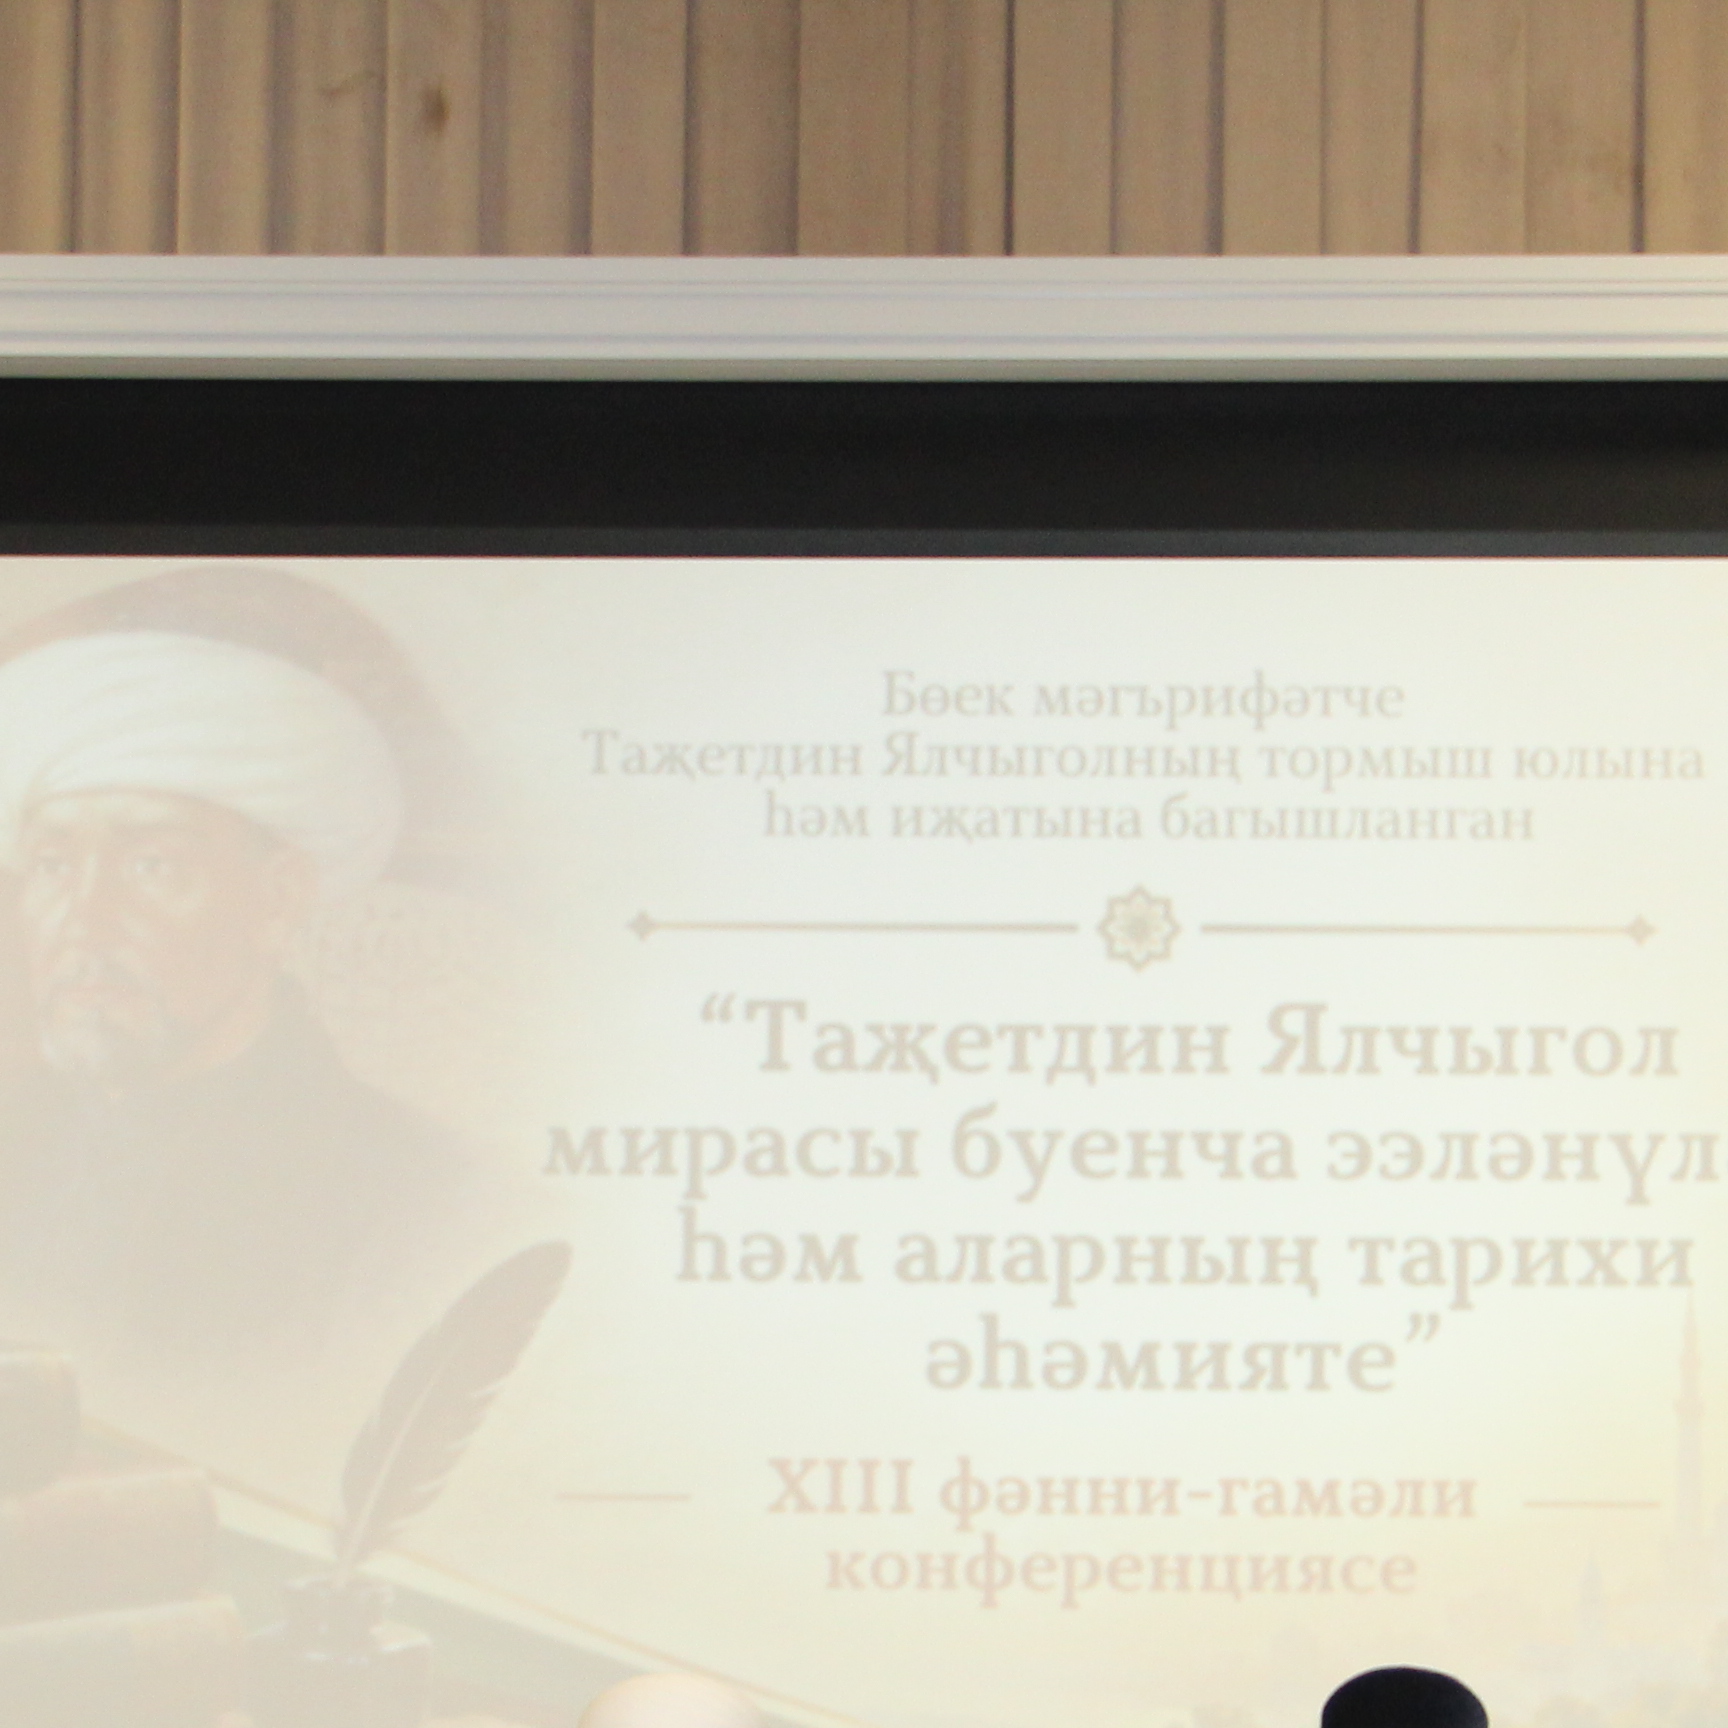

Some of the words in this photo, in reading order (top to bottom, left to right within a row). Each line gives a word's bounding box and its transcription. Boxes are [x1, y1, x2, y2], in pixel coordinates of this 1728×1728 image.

[881, 668, 1014, 718] Бөек
[1032, 667, 1406, 730] мәгърифәтче
[580, 727, 864, 783] Таҗетдин
[880, 728, 1242, 784] Ялчыголның
[1257, 744, 1494, 792] тормыш
[1512, 745, 1706, 781] юлына
[763, 787, 871, 839] һәм
[890, 804, 1144, 844] иҗатына
[1158, 785, 1535, 842] багышланган
[699, 992, 1231, 1087] “Таҗетдин
[1259, 1000, 1679, 1078] Ялчыгол
[543, 1125, 920, 1206] мирасы
[950, 1100, 1298, 1205] буенча
[675, 1201, 864, 1285] һәм
[893, 1232, 1320, 1310] аларның
[1346, 1235, 1694, 1313] тарихи
[924, 1310, 1442, 1394] әһәмияте”
[766, 1456, 914, 1516] XIII
[937, 1453, 1477, 1540] фәнни-гамәли
[825, 1530, 1418, 1612] конференциясе
